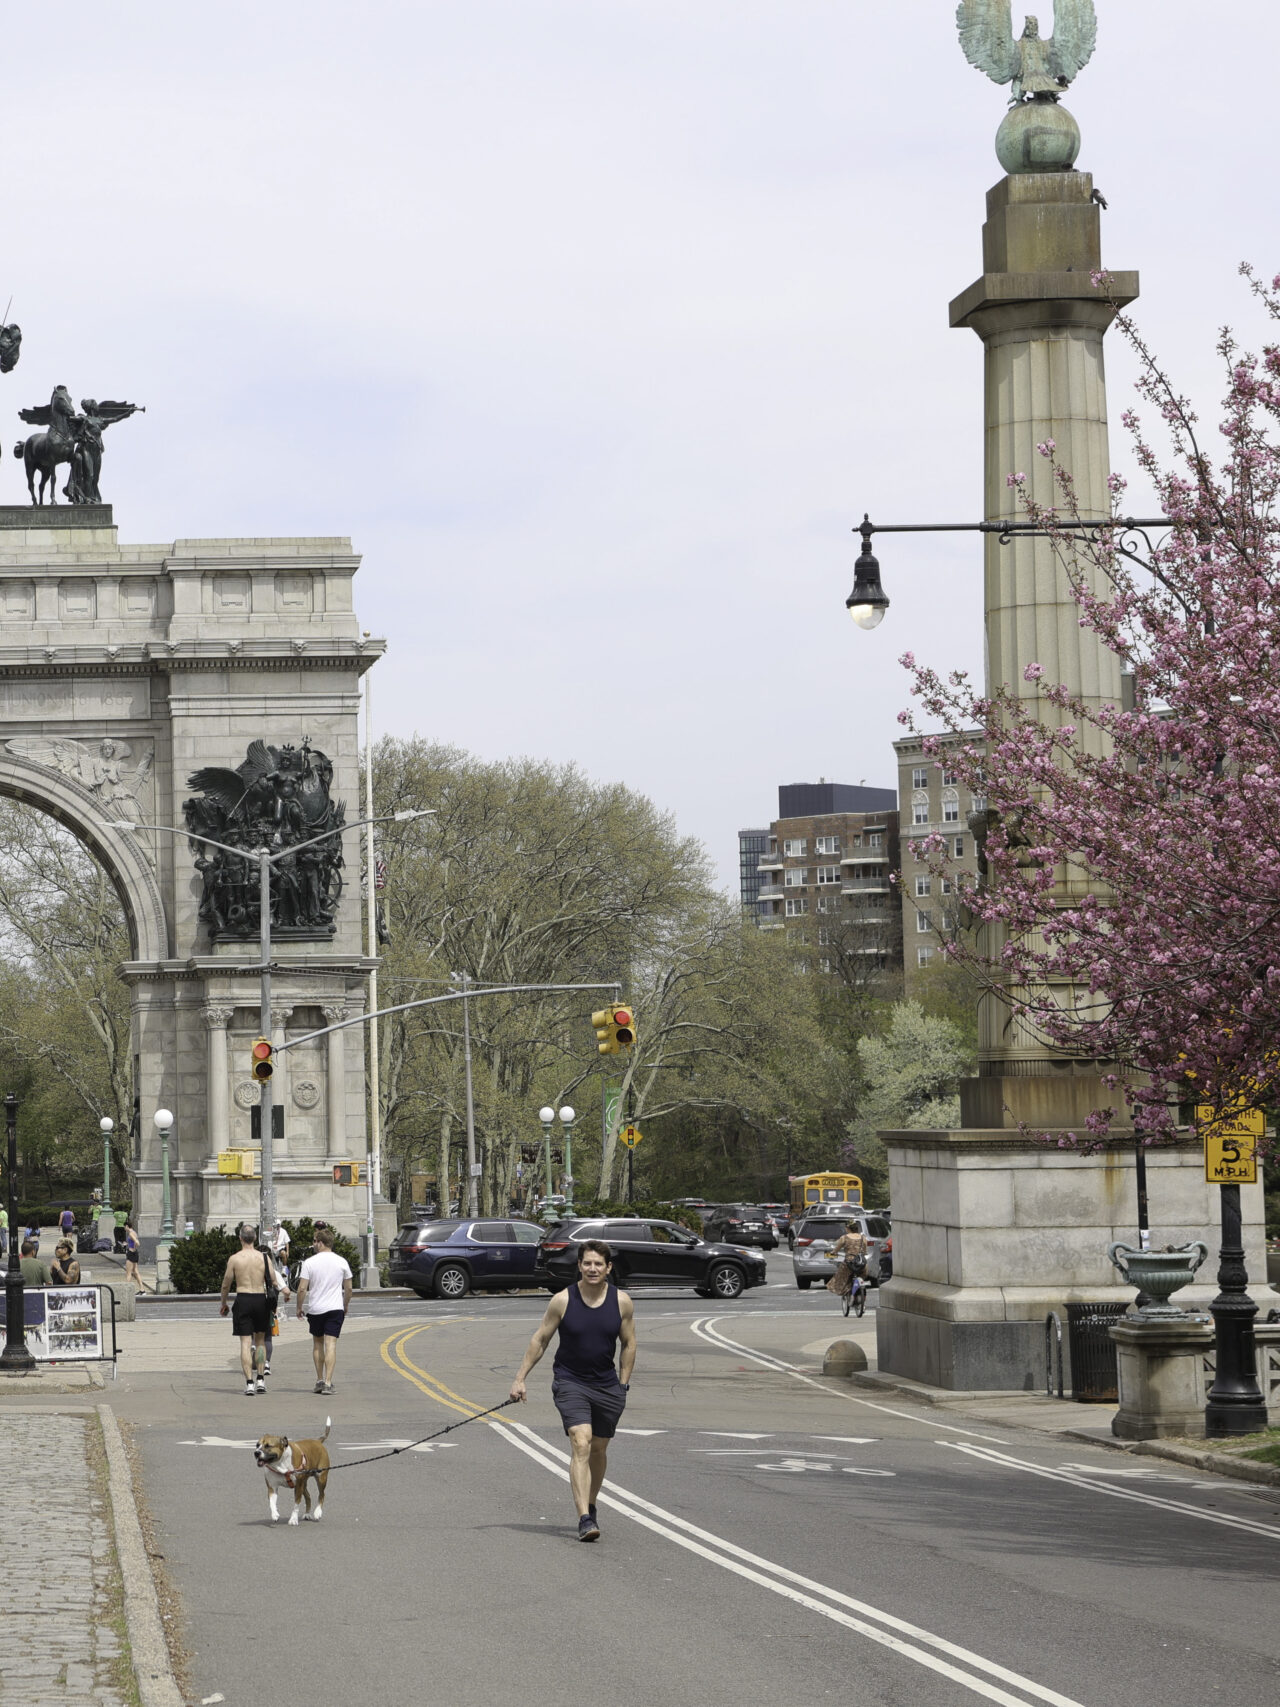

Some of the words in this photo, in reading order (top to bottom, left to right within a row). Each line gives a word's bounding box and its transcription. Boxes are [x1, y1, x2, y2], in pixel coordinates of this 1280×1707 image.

[1240, 1109, 1257, 1119] THE
[1217, 1121, 1244, 1132] ROAD
[1222, 1139, 1241, 1163] 5
